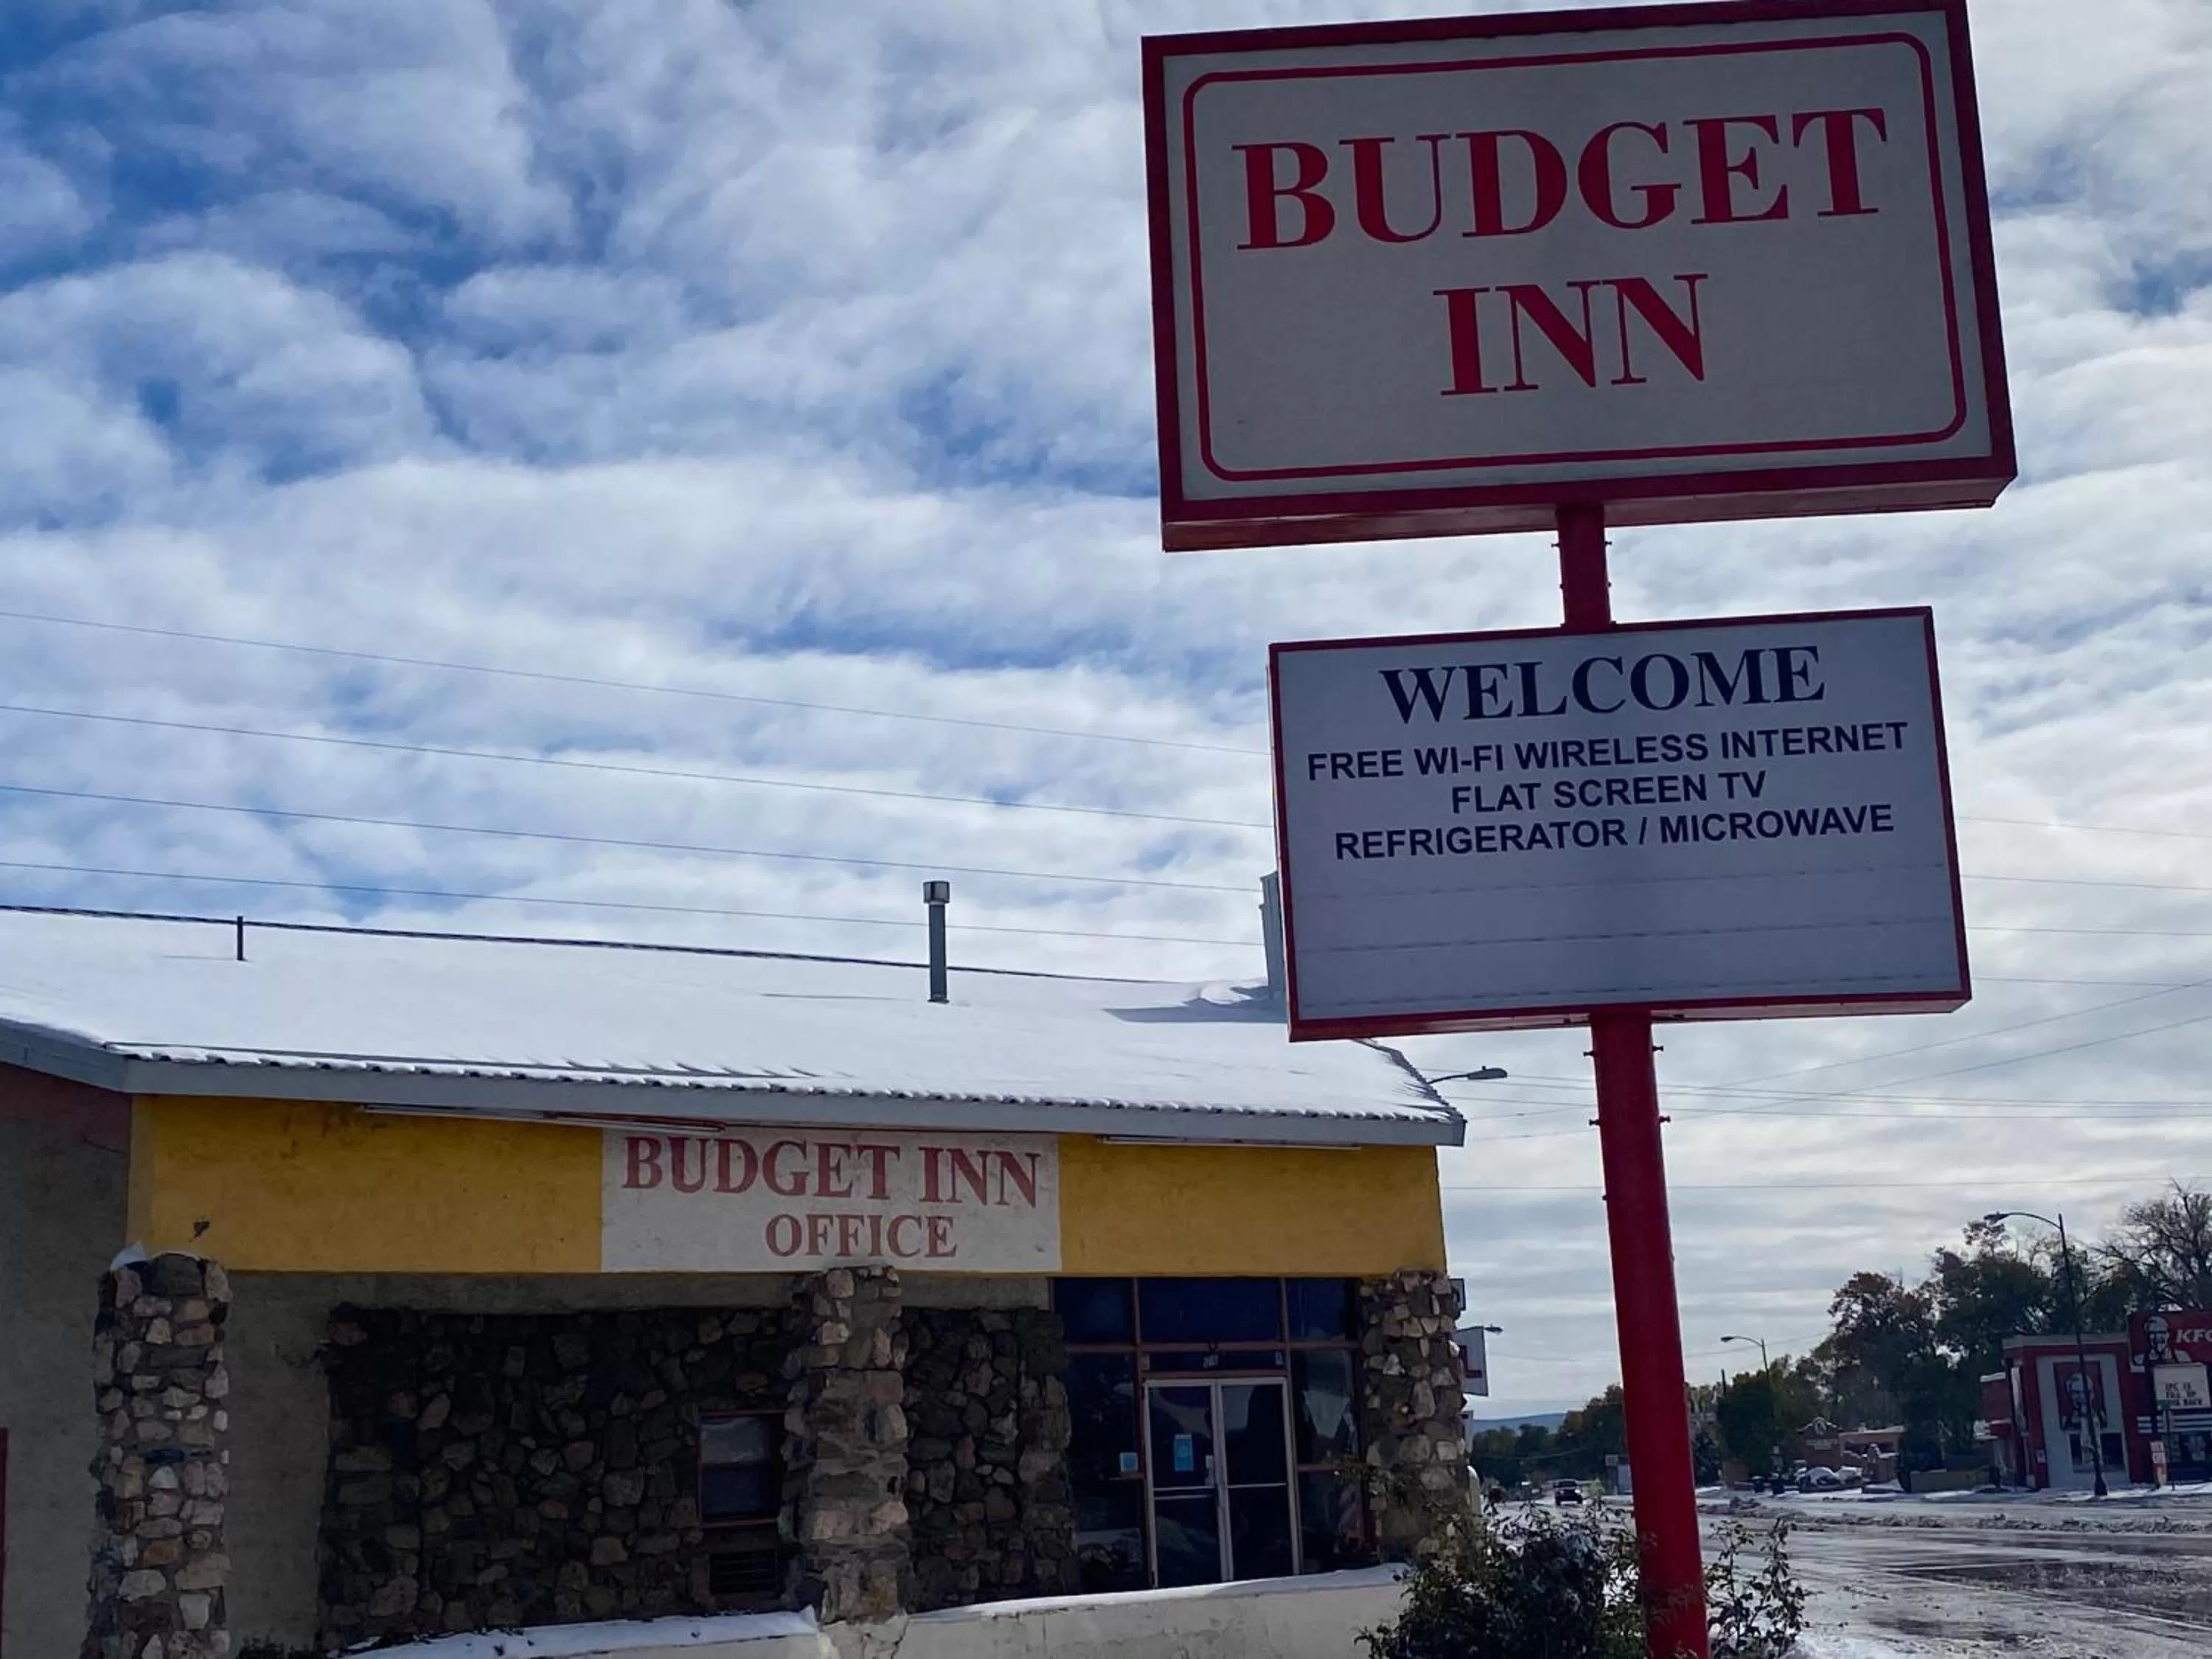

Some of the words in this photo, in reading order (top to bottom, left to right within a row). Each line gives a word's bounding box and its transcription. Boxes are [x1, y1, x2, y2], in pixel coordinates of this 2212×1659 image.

[1231, 108, 1888, 250] BUDGET
[1433, 274, 1708, 396] INN
[1379, 645, 1825, 725] WELCOME
[1307, 749, 1405, 781] FREE
[1413, 744, 1503, 776] WI-FI
[1514, 733, 1709, 771] WIRELESS
[1720, 721, 1908, 759] INTERNET
[1452, 782, 1542, 814] FLAT
[1554, 773, 1708, 809] SCREEN
[1717, 770, 1766, 799] TV
[1335, 818, 1629, 860] REFRIGERATOR
[1660, 804, 1894, 844] MICROWAVE
[622, 1136, 900, 1200] BUDGET
[919, 1147, 1041, 1208] INN
[765, 1214, 957, 1258] OFFICE
